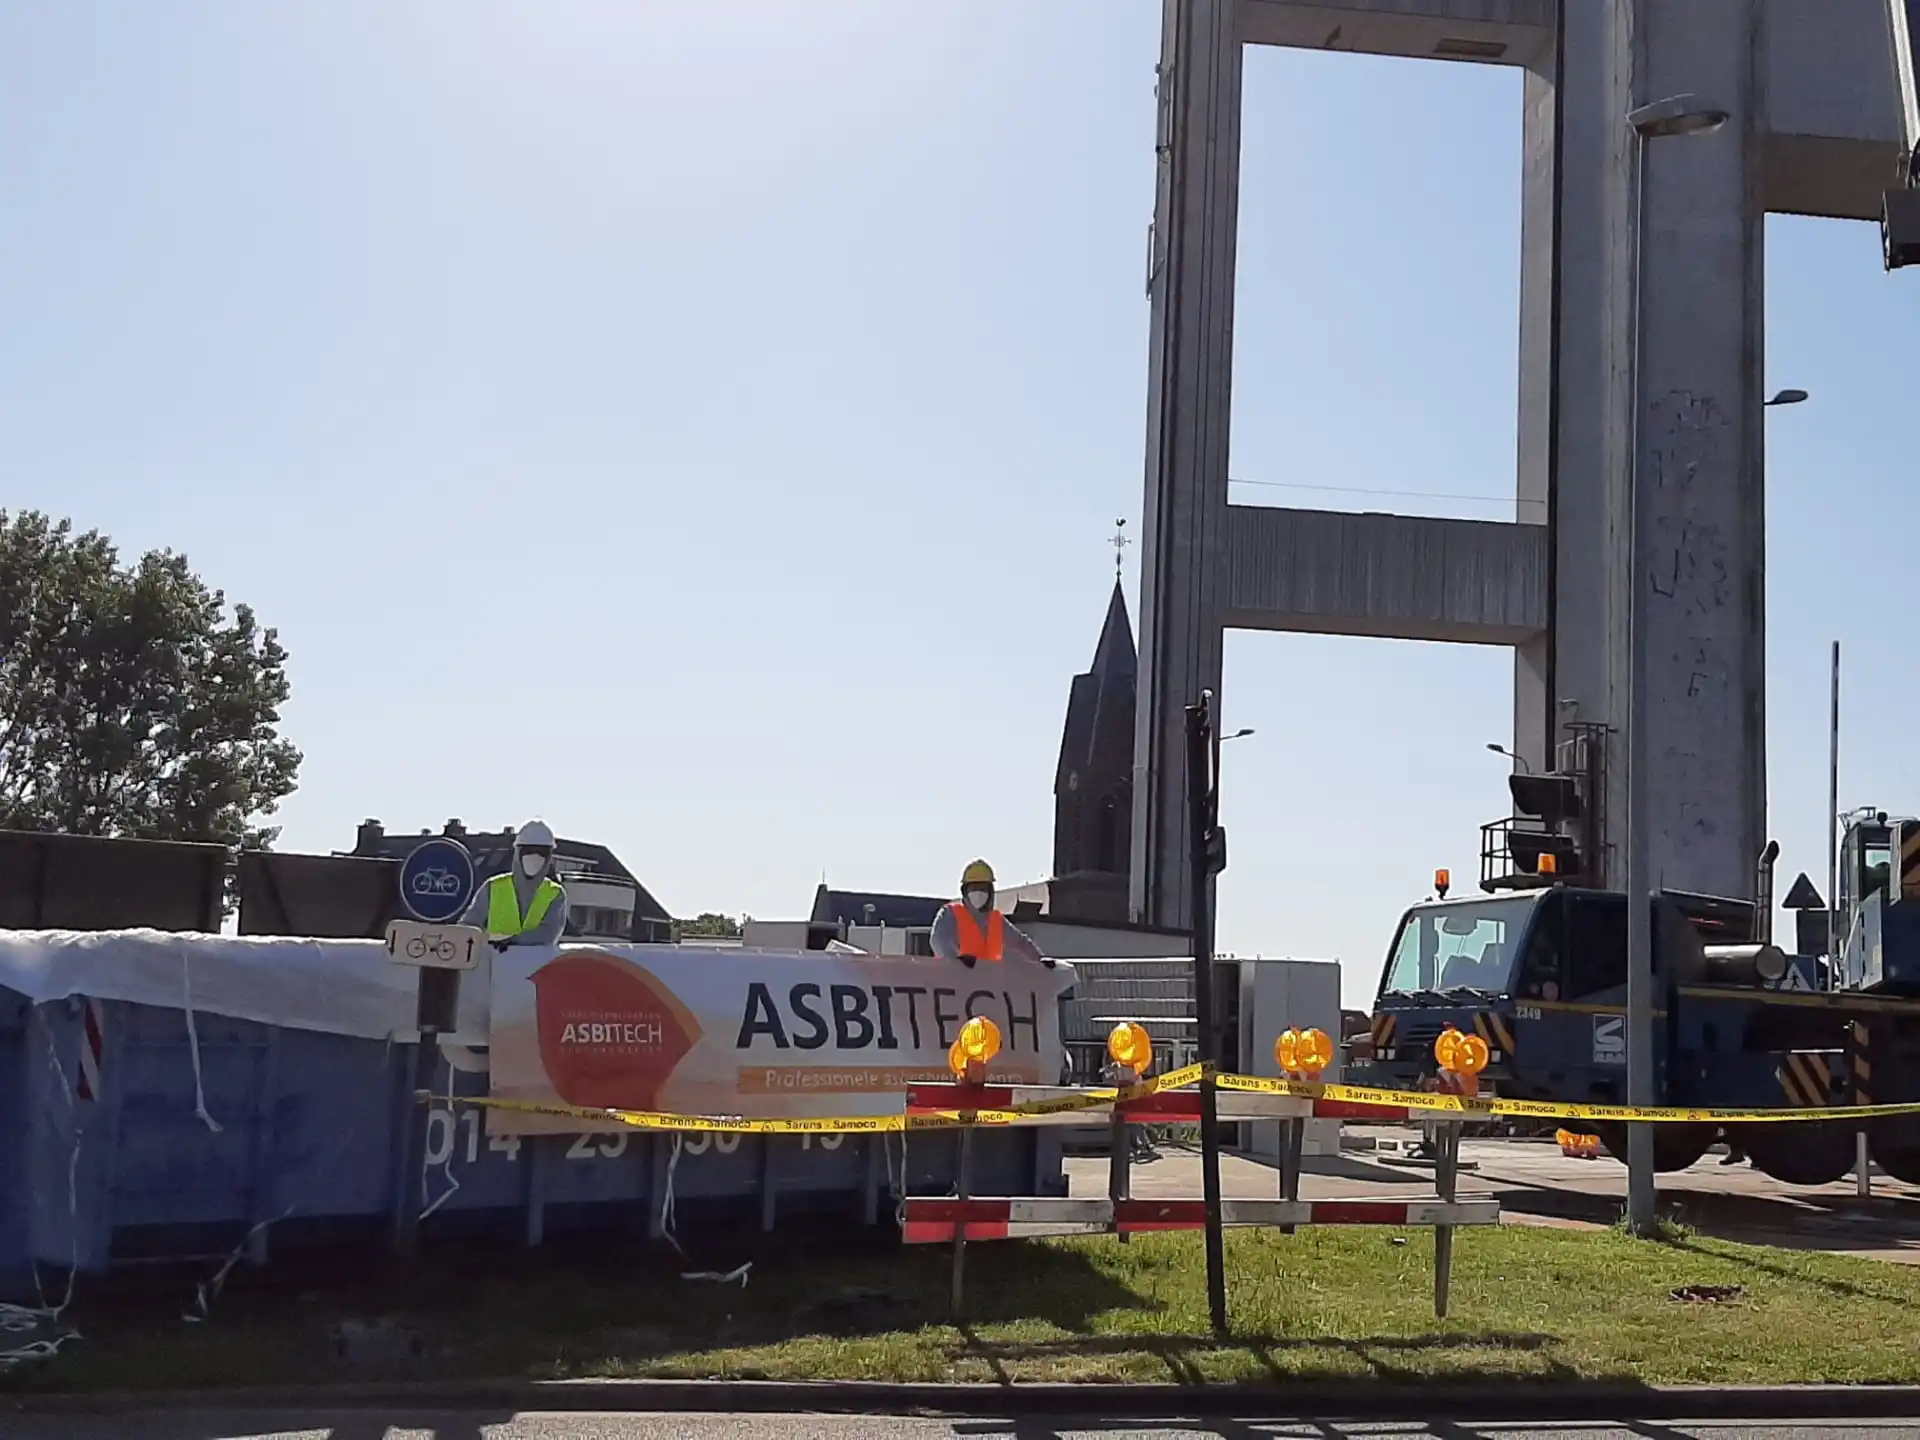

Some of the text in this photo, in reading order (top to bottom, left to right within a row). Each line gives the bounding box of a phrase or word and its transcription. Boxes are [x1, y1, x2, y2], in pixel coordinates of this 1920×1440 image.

[736, 981, 1040, 1053] ASBITECH
[560, 1023, 662, 1043] ASBITECH
[765, 1069, 878, 1088] Professionele
[1159, 1072, 1195, 1089] Sarens
[1222, 1075, 1260, 1089] Sarens
[1345, 1089, 1382, 1101] Sarens
[1391, 1092, 1436, 1106] Samoco
[1513, 1102, 1556, 1114] Samoco
[709, 1118, 751, 1129] Samoco
[833, 1120, 877, 1130] Samoco
